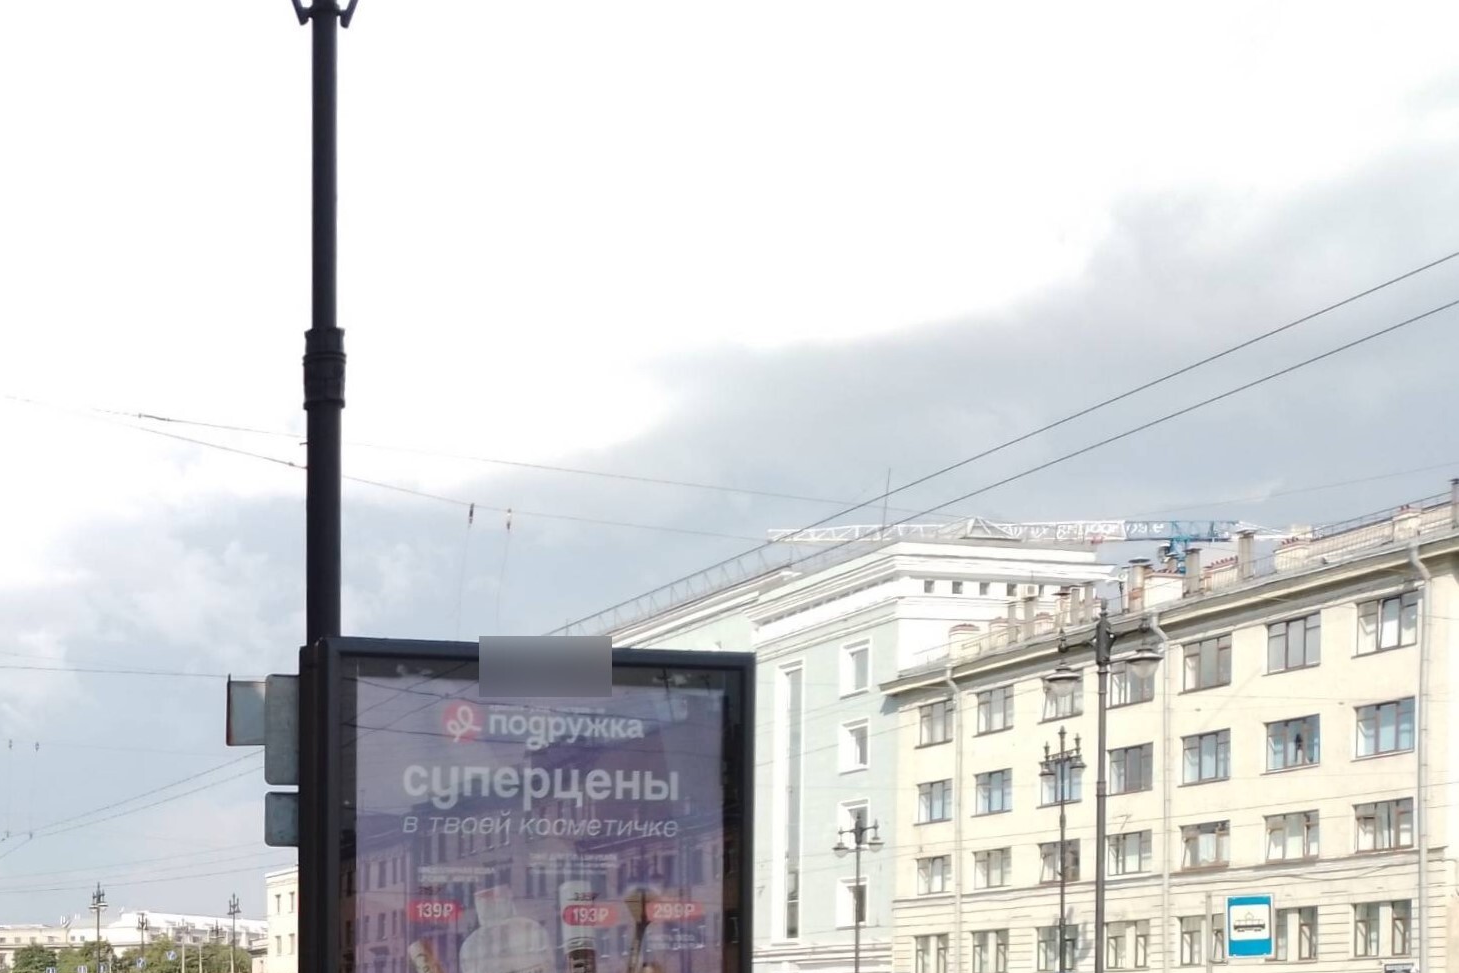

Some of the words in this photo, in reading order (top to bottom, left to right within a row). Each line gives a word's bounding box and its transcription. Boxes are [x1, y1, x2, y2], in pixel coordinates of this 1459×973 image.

[489, 713, 644, 750] подружка
[403, 763, 679, 811] суперцены
[403, 816, 418, 833] в
[429, 811, 511, 835] твоей
[519, 817, 679, 838] косметичке
